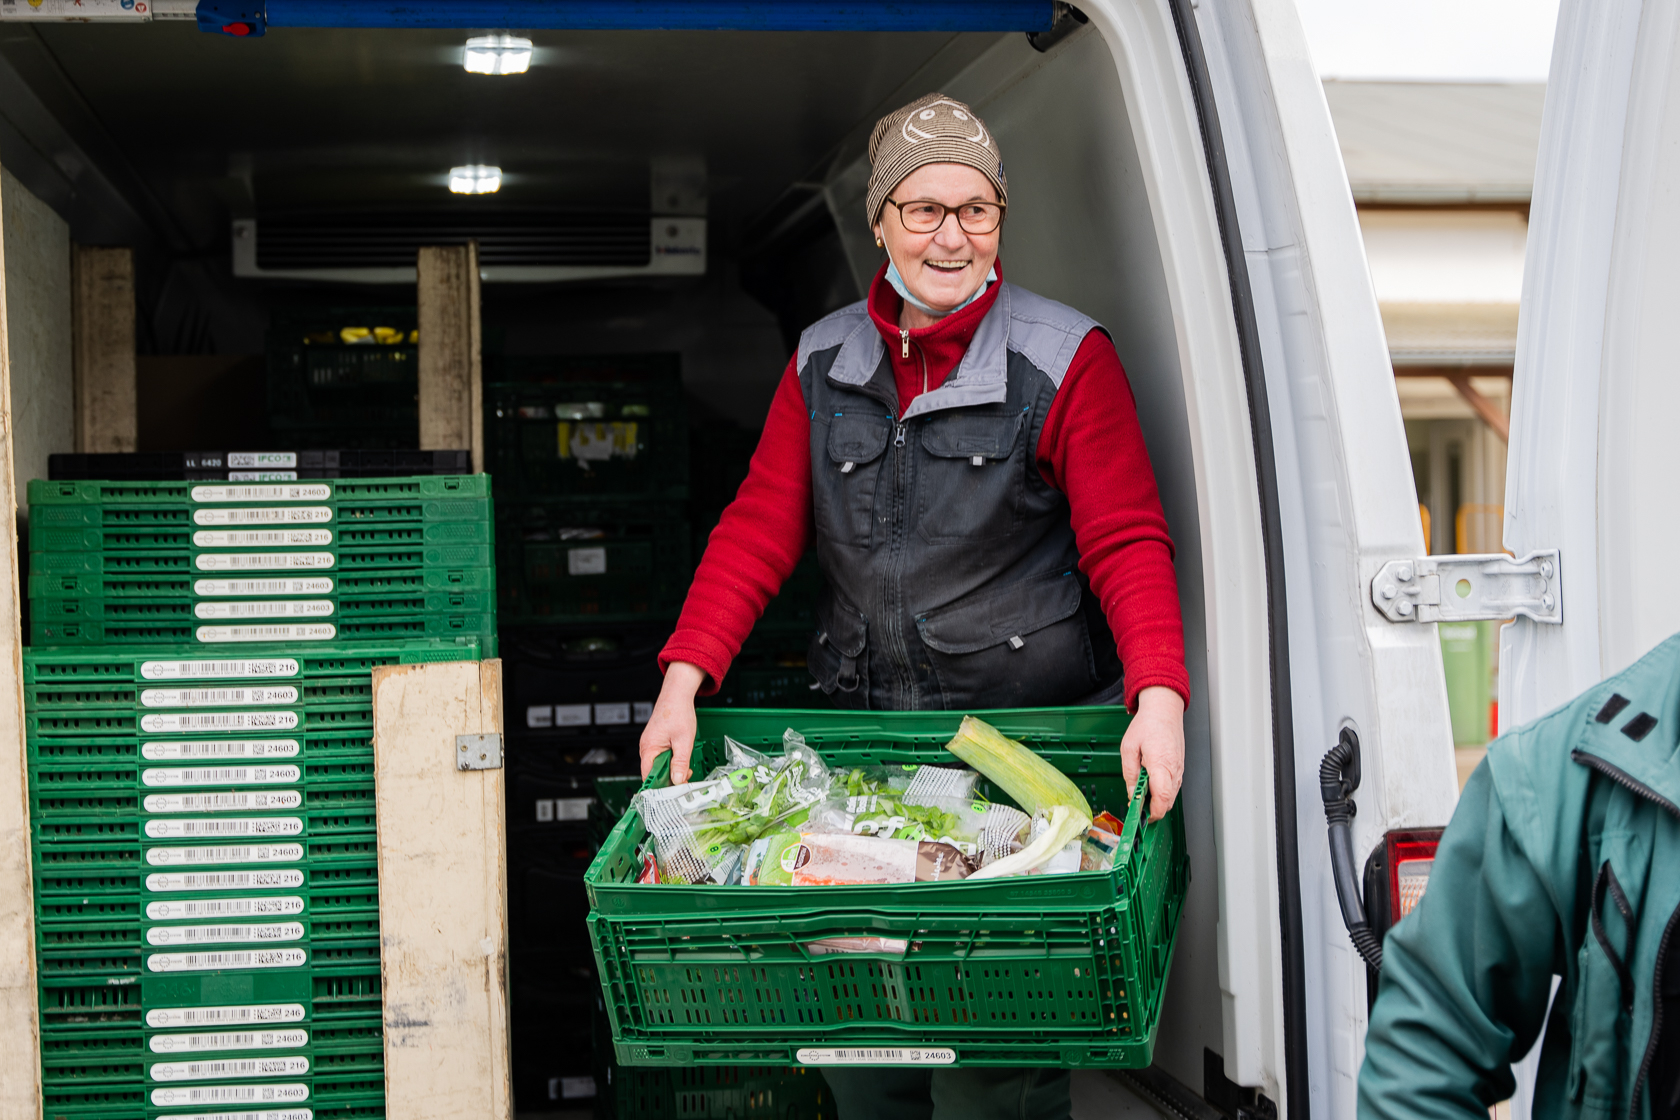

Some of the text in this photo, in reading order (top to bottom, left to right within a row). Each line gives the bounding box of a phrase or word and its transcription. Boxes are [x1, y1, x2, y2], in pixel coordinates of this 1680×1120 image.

[306, 582, 329, 590] 24603
[306, 604, 330, 612] 24603
[309, 627, 332, 635] 24603
[279, 663, 295, 672] 216
[267, 691, 294, 700] 24603
[278, 716, 294, 725] 216
[267, 744, 294, 753] 24603
[269, 769, 296, 779] 24603
[270, 795, 297, 804] 24603
[283, 823, 299, 832] 216
[273, 848, 299, 857] 24603
[284, 874, 300, 883] 216
[285, 901, 301, 910] 216
[285, 927, 300, 936] 216
[286, 953, 302, 962] 216
[285, 1009, 301, 1018] 246
[276, 1034, 303, 1043] 24603
[925, 1051, 952, 1060] 24603
[290, 1061, 306, 1070] 216
[277, 1088, 304, 1098] 24603
